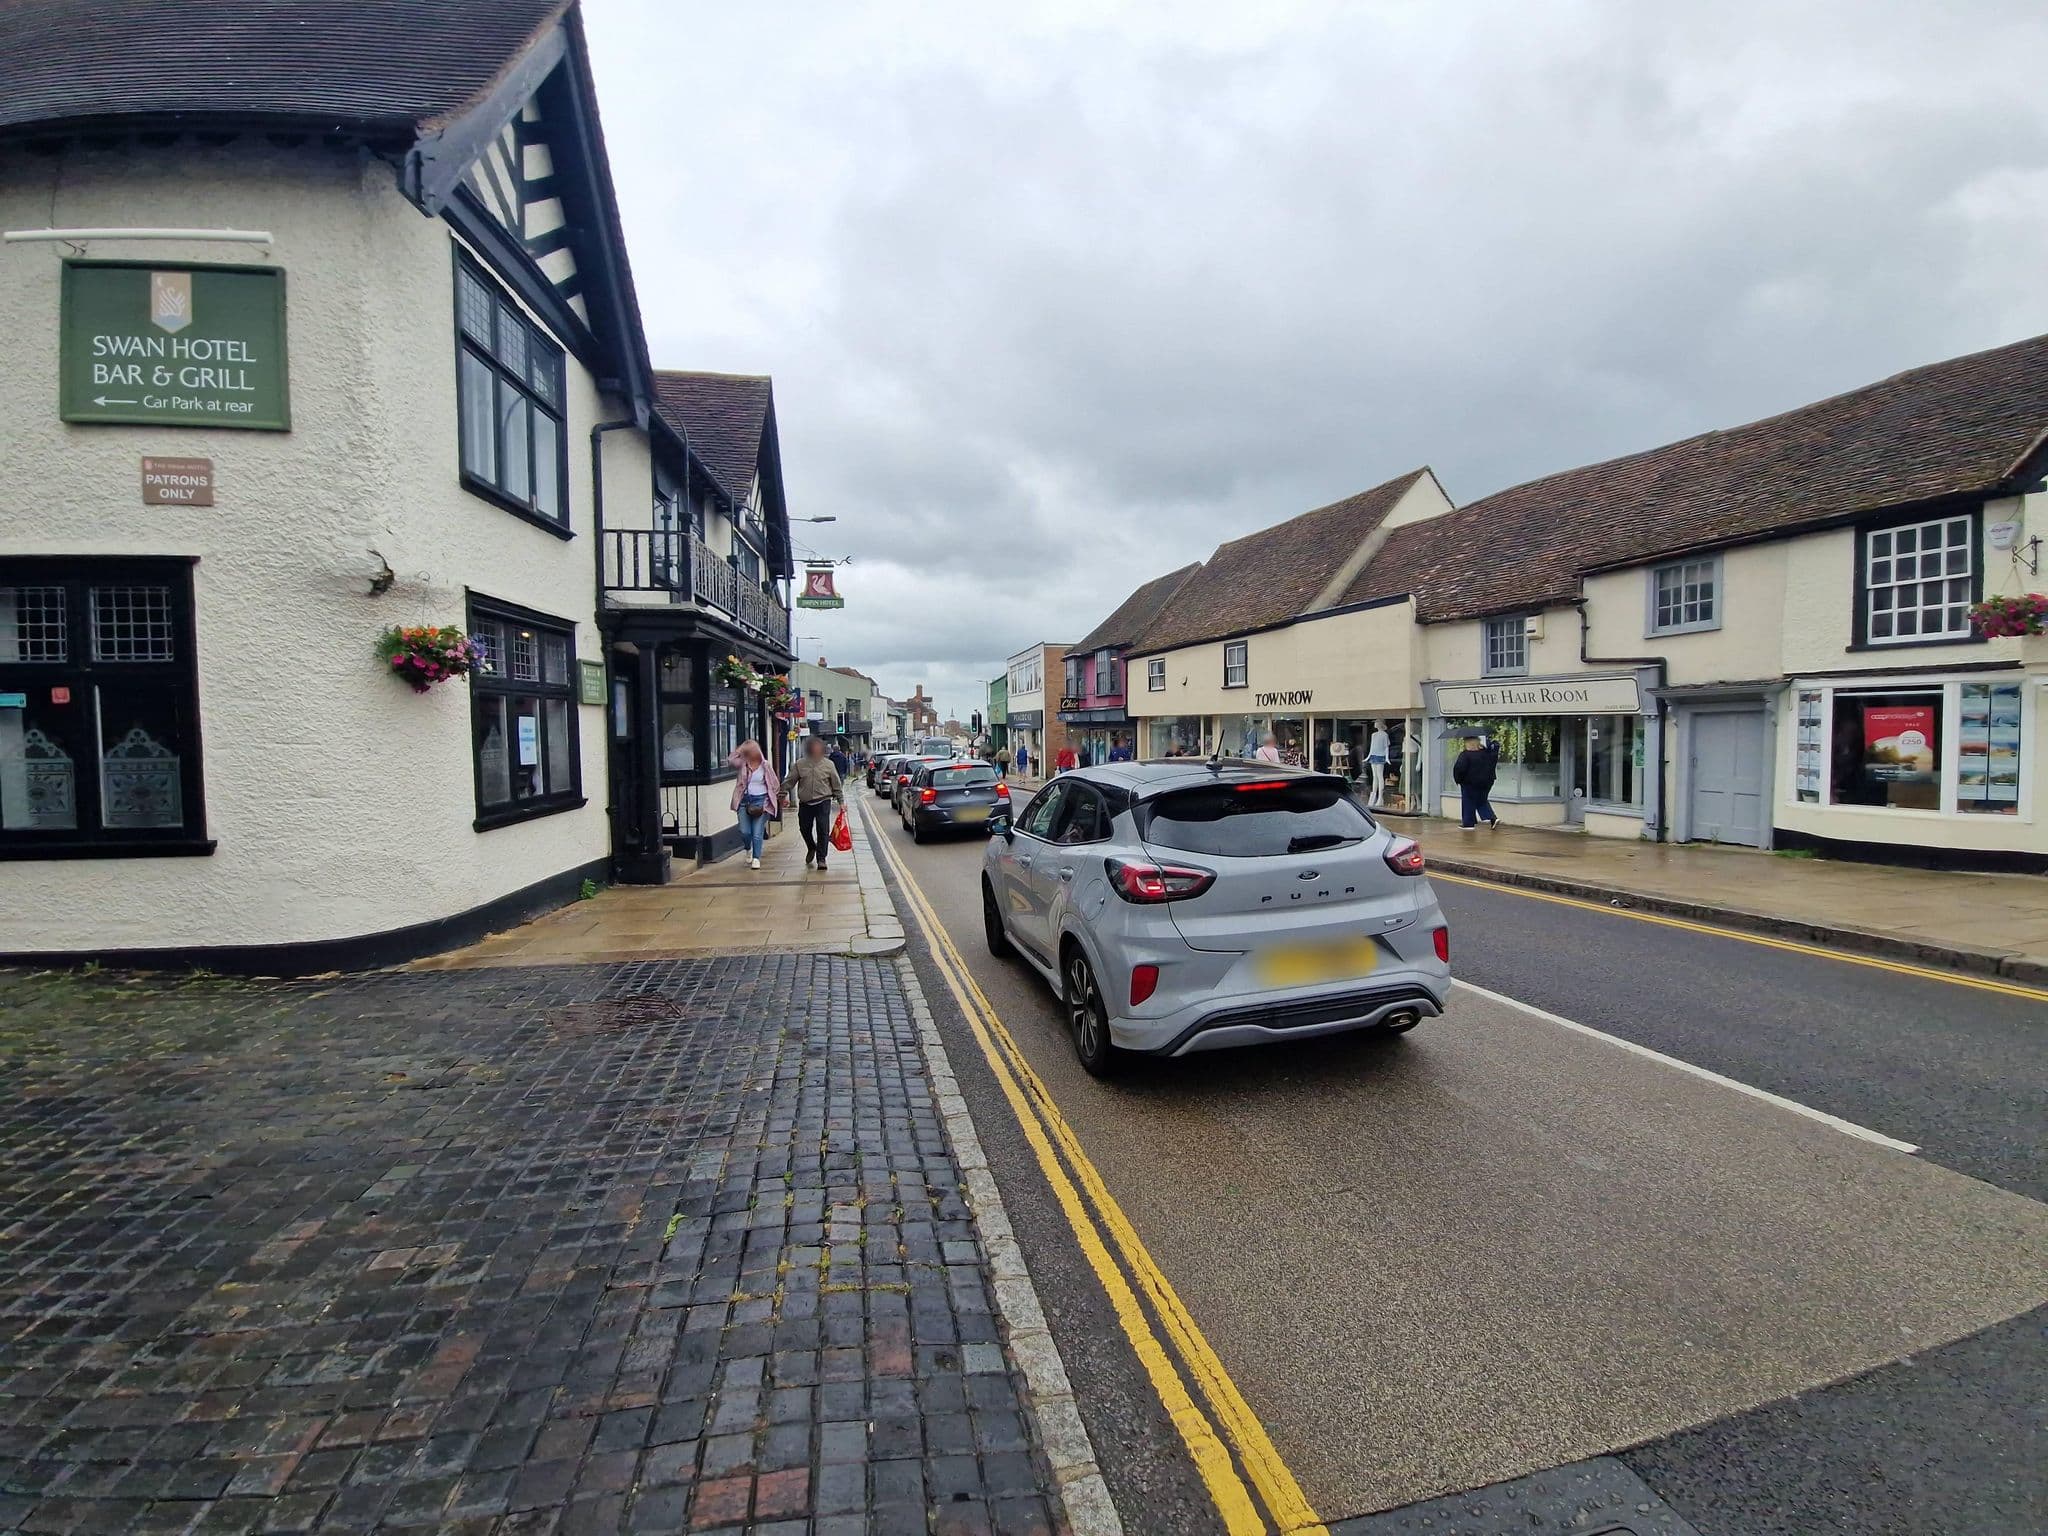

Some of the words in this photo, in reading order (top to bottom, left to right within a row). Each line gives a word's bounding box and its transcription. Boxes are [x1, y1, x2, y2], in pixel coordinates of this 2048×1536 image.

[93, 335, 165, 357] SWAN
[172, 337, 257, 362] HOTEL
[93, 363, 145, 385] BAR
[152, 365, 174, 387] &
[179, 367, 256, 390] GRILL
[143, 395, 169, 409] Car
[172, 396, 204, 411] Park
[207, 399, 222, 412] at
[225, 402, 254, 413] rear
[146, 474, 209, 486] PATRONS
[159, 488, 195, 499] ONLY
[1255, 690, 1313, 707] TOWNROW
[1261, 886, 1355, 903] PUMA
